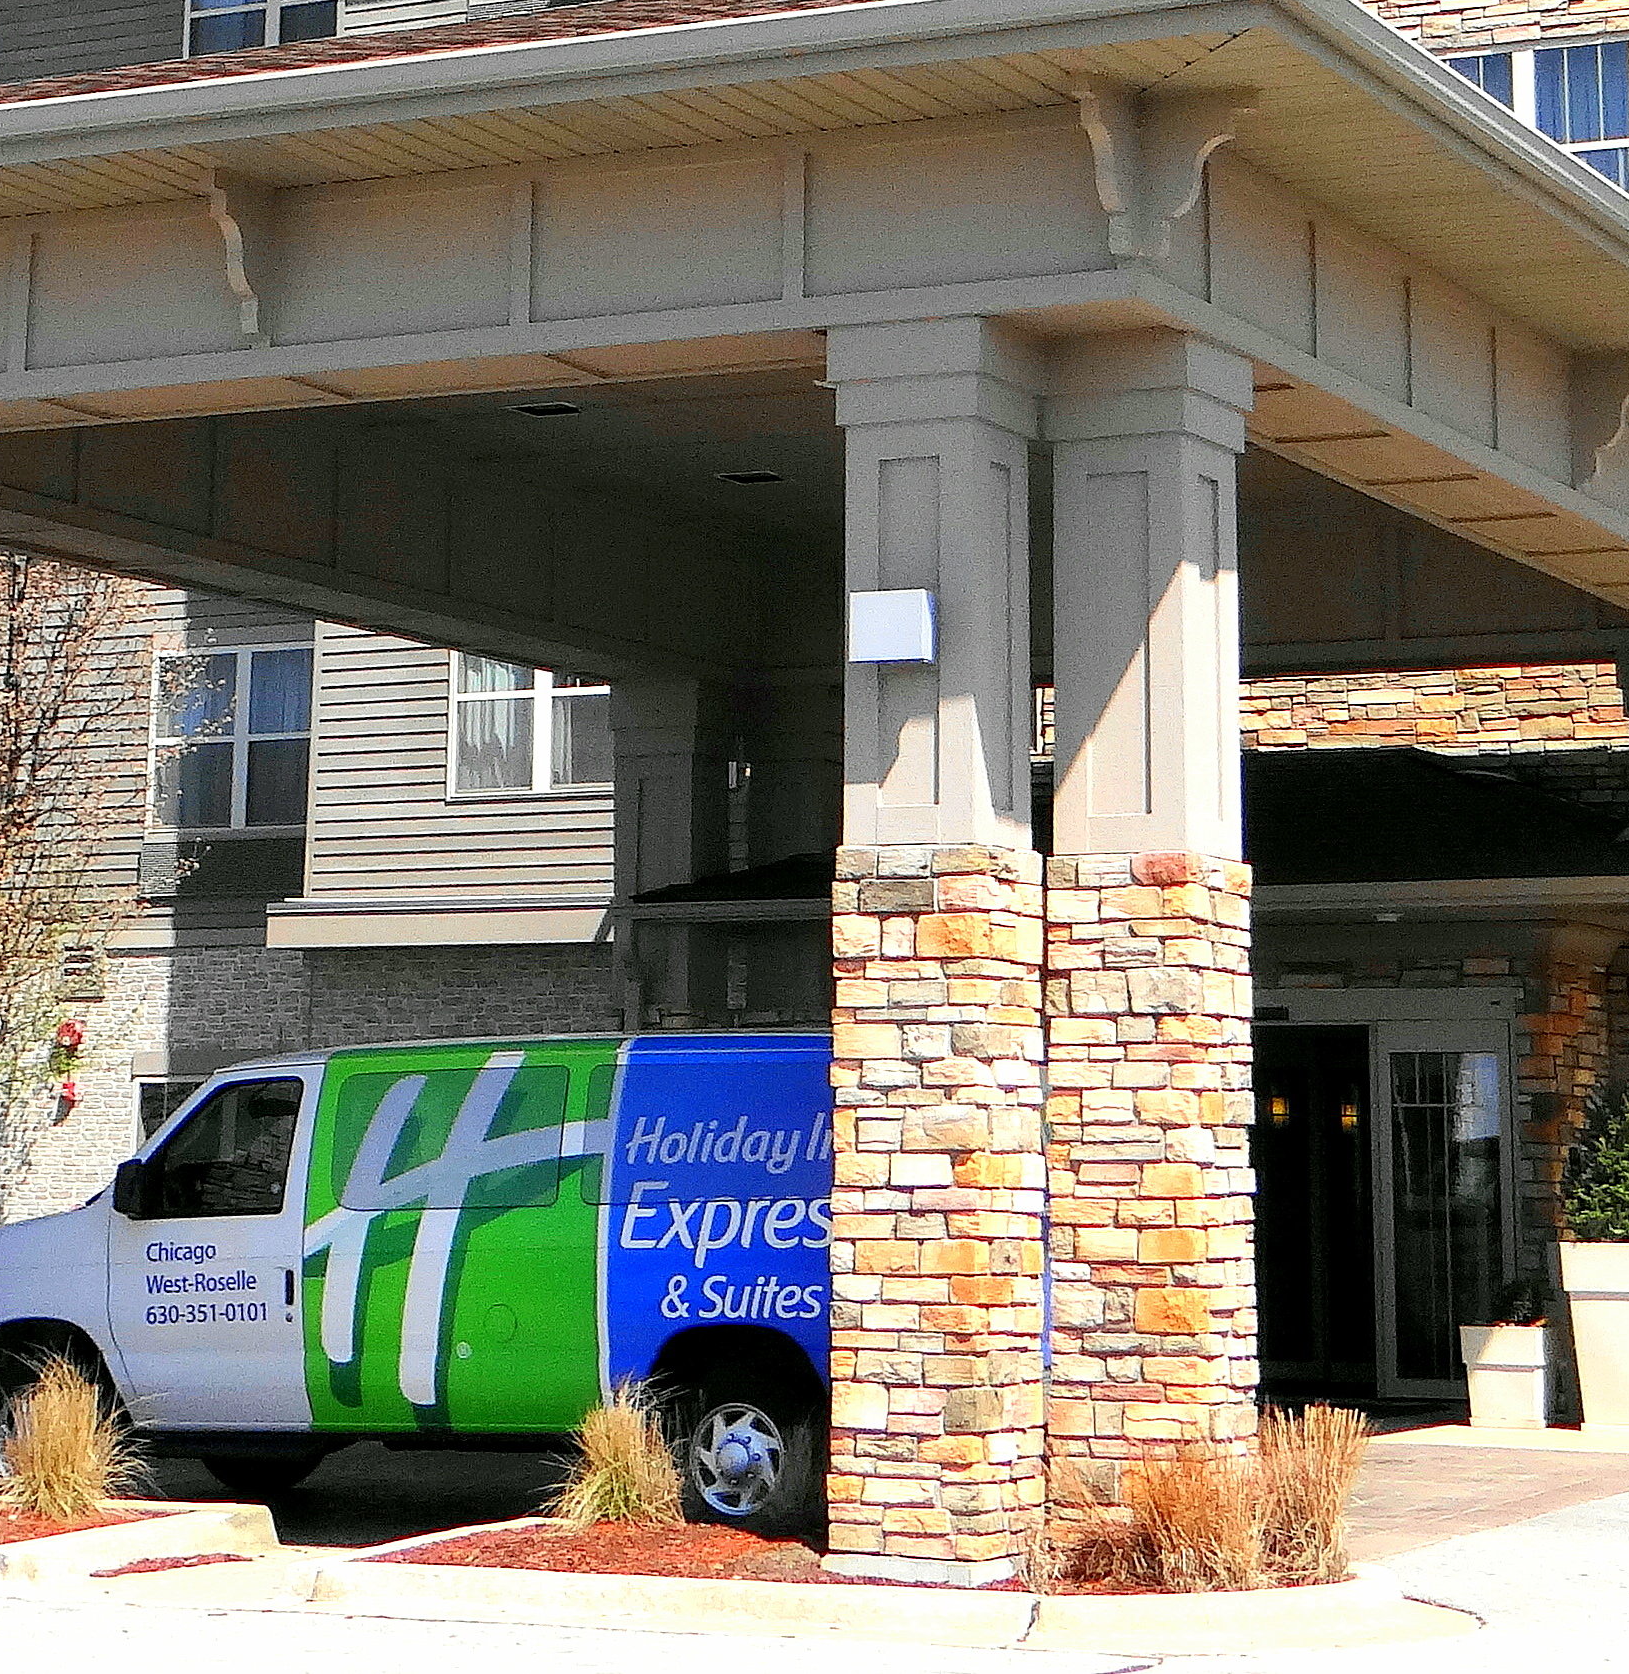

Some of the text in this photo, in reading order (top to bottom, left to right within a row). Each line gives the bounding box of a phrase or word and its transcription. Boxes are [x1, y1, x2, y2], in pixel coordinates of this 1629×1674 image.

[626, 1115, 801, 1174] Holiday
[620, 1180, 834, 1269] Expres
[146, 1241, 217, 1264] Chicago
[146, 1270, 257, 1294] West-Roselle
[660, 1275, 824, 1319] & Suites
[146, 1302, 268, 1325] 630-351-0101
